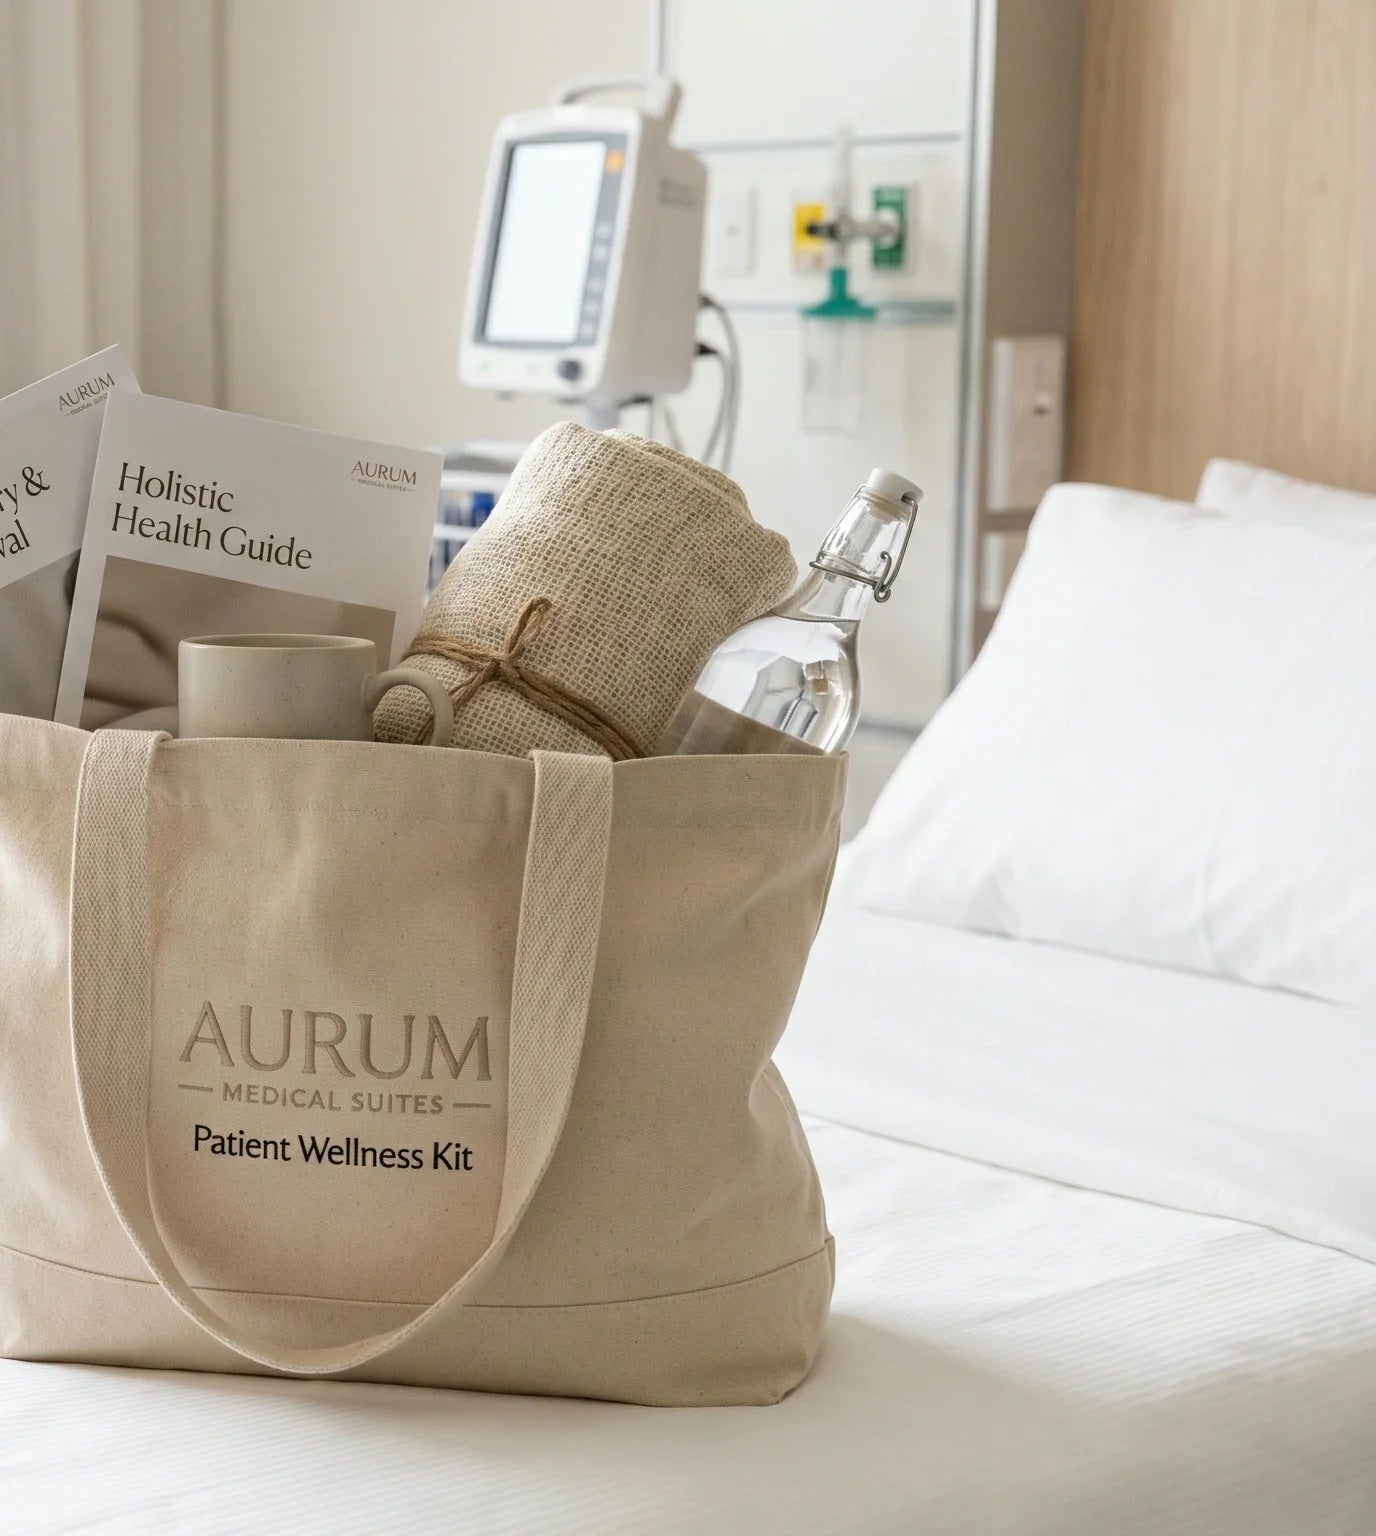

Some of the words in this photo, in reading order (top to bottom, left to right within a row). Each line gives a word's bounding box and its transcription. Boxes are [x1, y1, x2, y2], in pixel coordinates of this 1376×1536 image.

[59, 372, 115, 412] AURUM
[21, 466, 51, 497] &
[118, 462, 234, 513] Holistic
[350, 460, 417, 486] AURUM
[111, 502, 212, 550] Health
[220, 526, 313, 570] Guide
[178, 1000, 492, 1081] AURUM
[222, 1082, 342, 1112] MEDICAL
[350, 1092, 443, 1115] SUITES
[193, 1124, 291, 1161] Patient
[297, 1134, 424, 1169] Wellness
[432, 1142, 474, 1171] Kit
